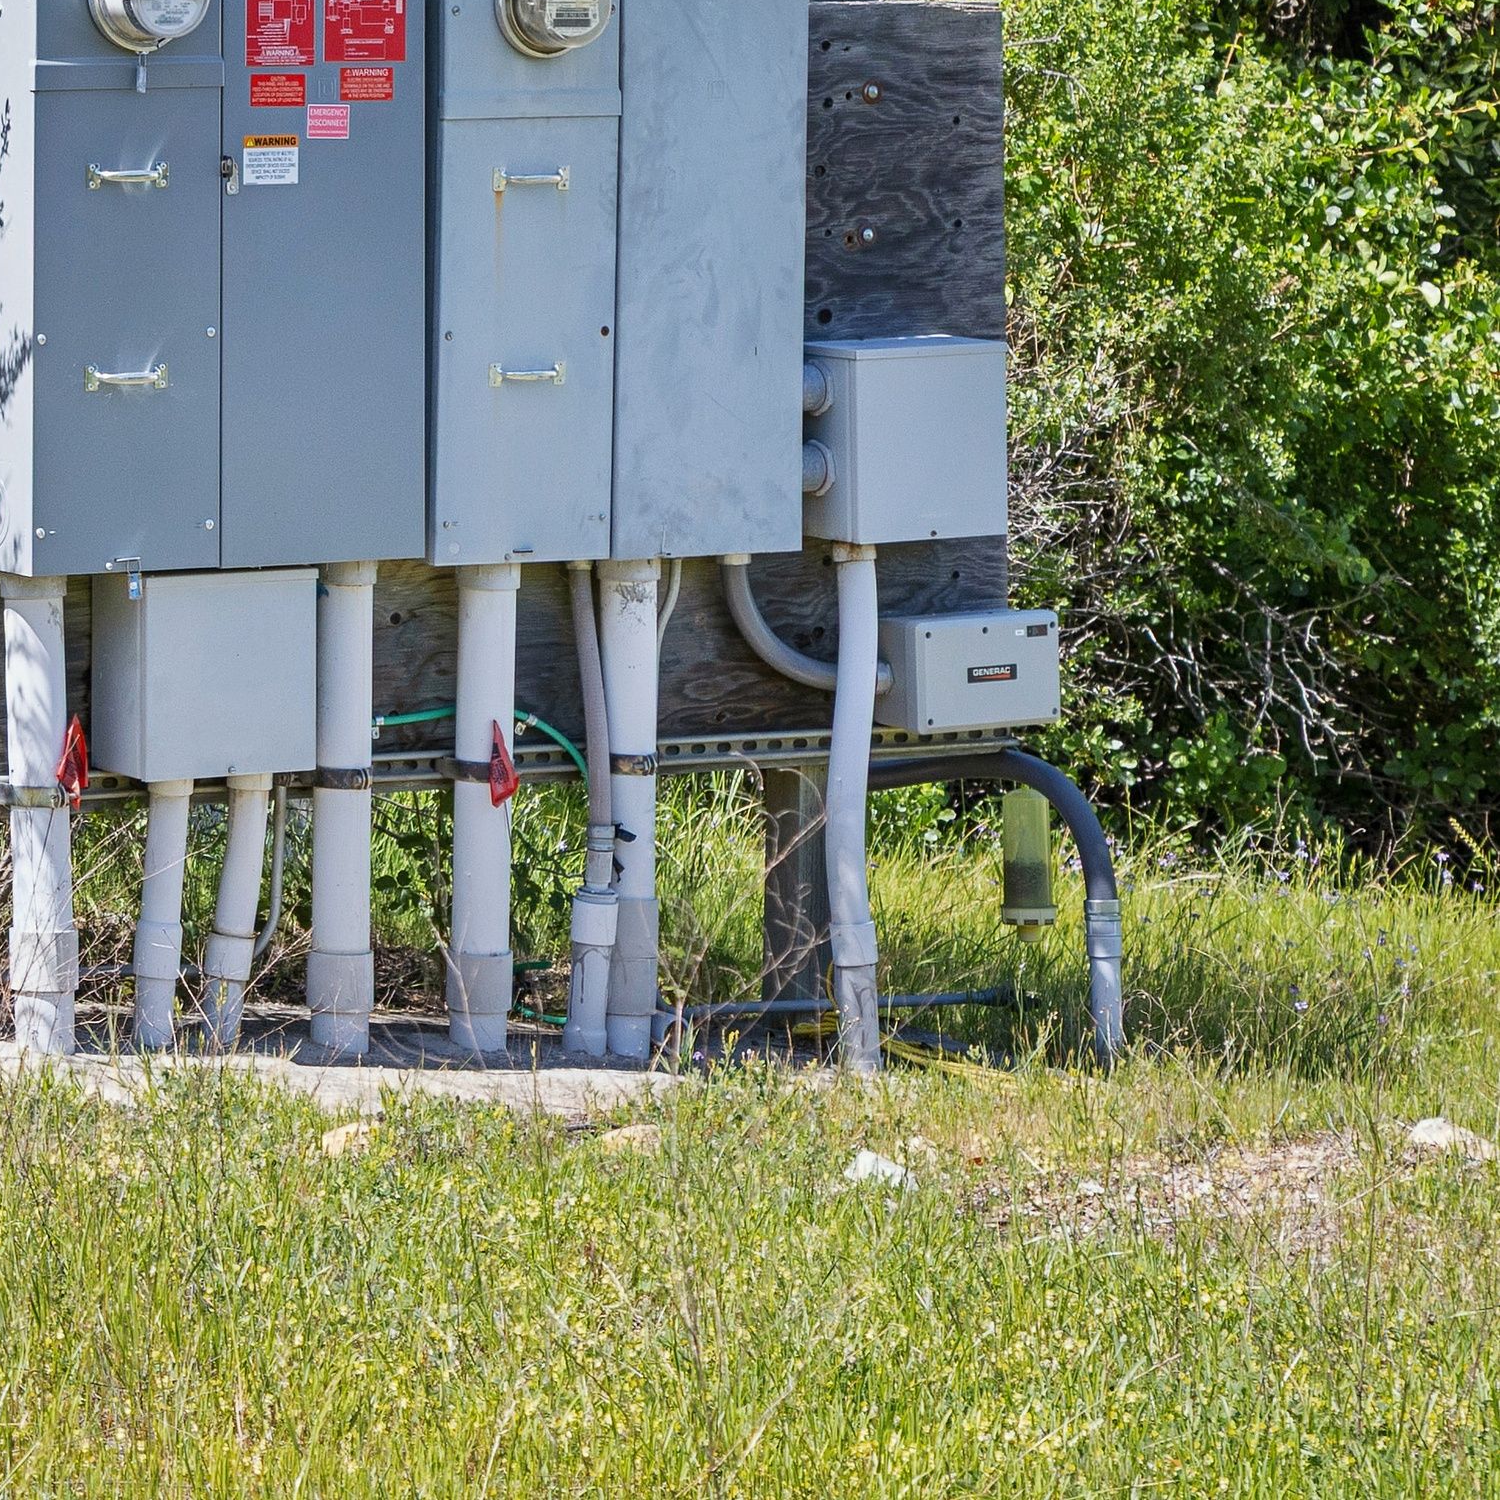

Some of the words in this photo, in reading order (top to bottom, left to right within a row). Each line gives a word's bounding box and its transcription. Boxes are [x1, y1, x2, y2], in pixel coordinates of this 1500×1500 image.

[310, 108, 347, 117] EMERGENCY
[309, 119, 347, 127] DISCONNECT
[254, 137, 296, 146] WARNING
[973, 667, 1011, 677] GENERAC
